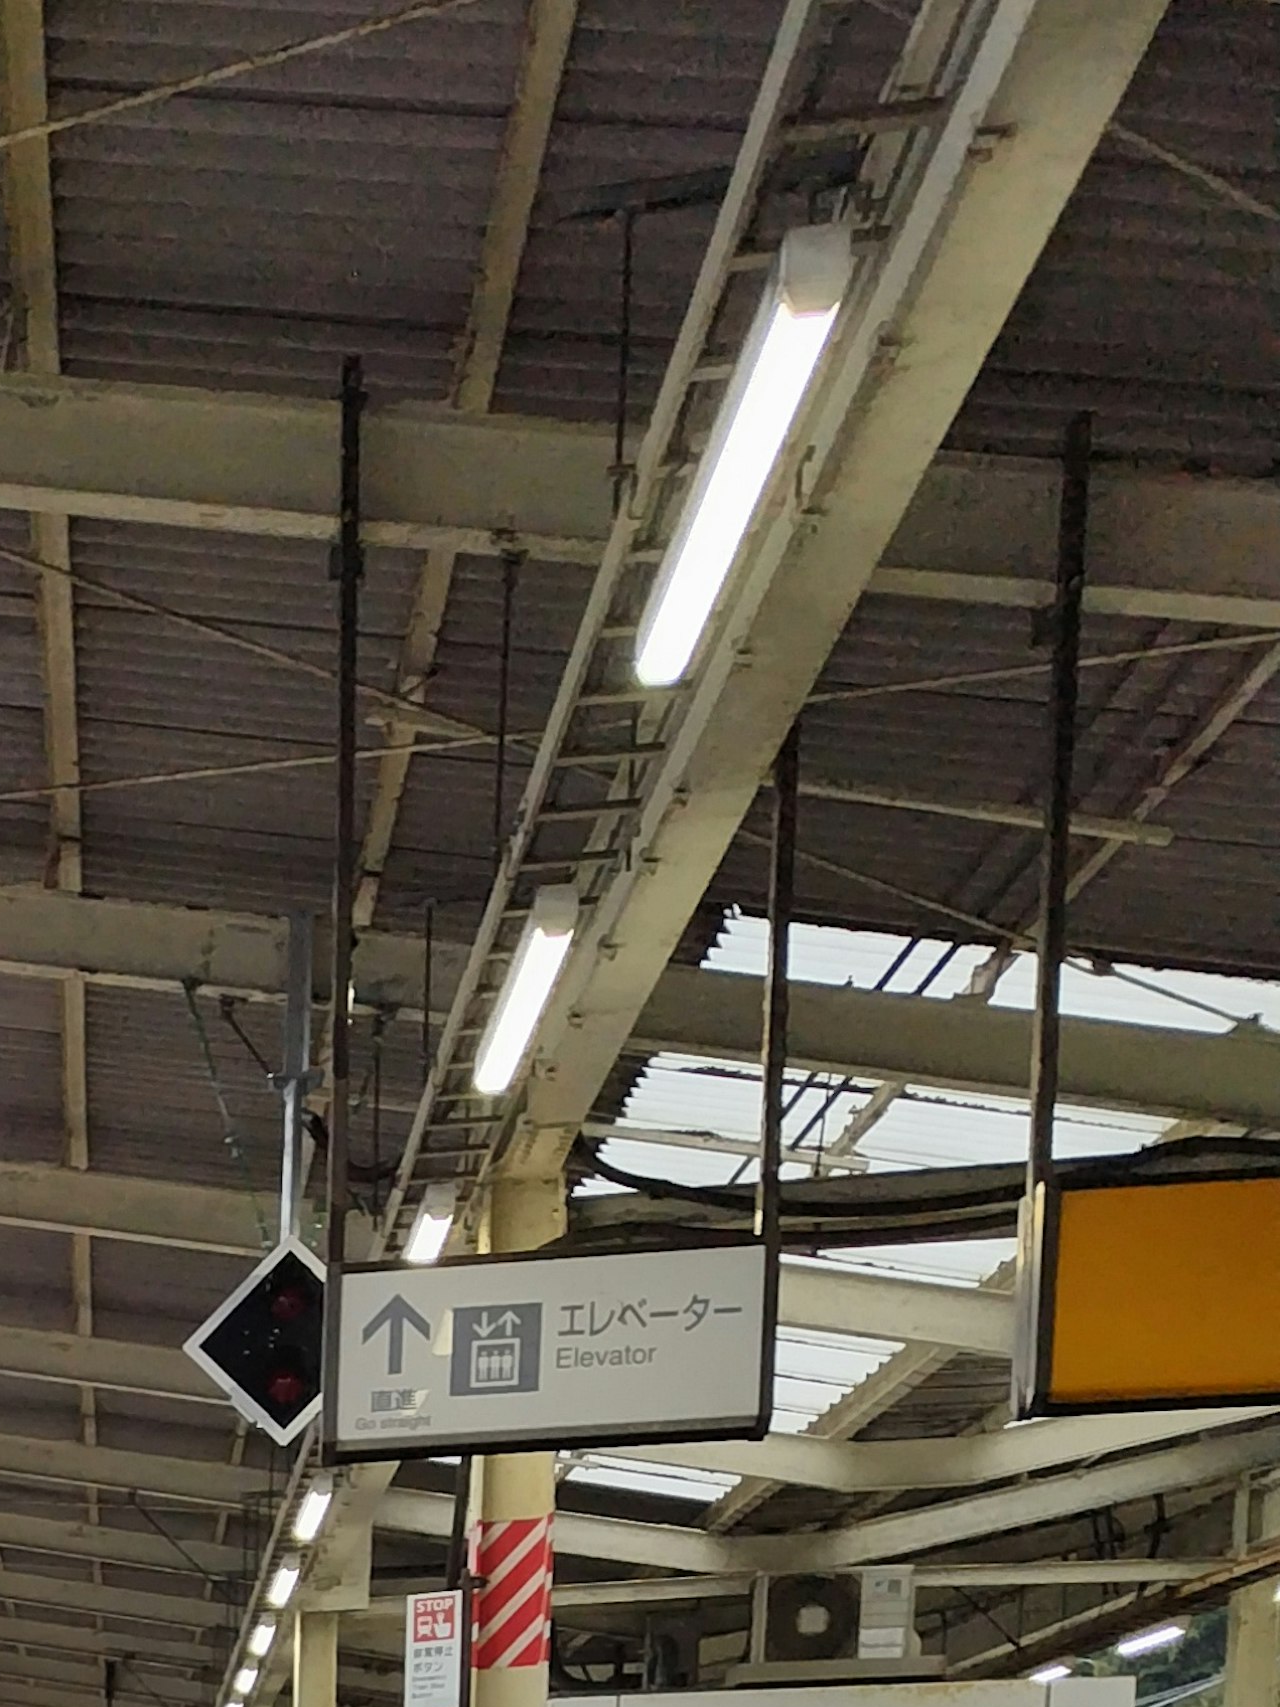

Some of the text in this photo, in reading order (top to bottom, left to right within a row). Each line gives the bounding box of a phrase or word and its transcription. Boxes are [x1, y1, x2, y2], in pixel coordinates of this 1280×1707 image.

[557, 1293, 744, 1337] エレベーター
[555, 1344, 657, 1370] Elevator
[355, 1416, 432, 1431] Go straight
[416, 1598, 454, 1614] STOP
